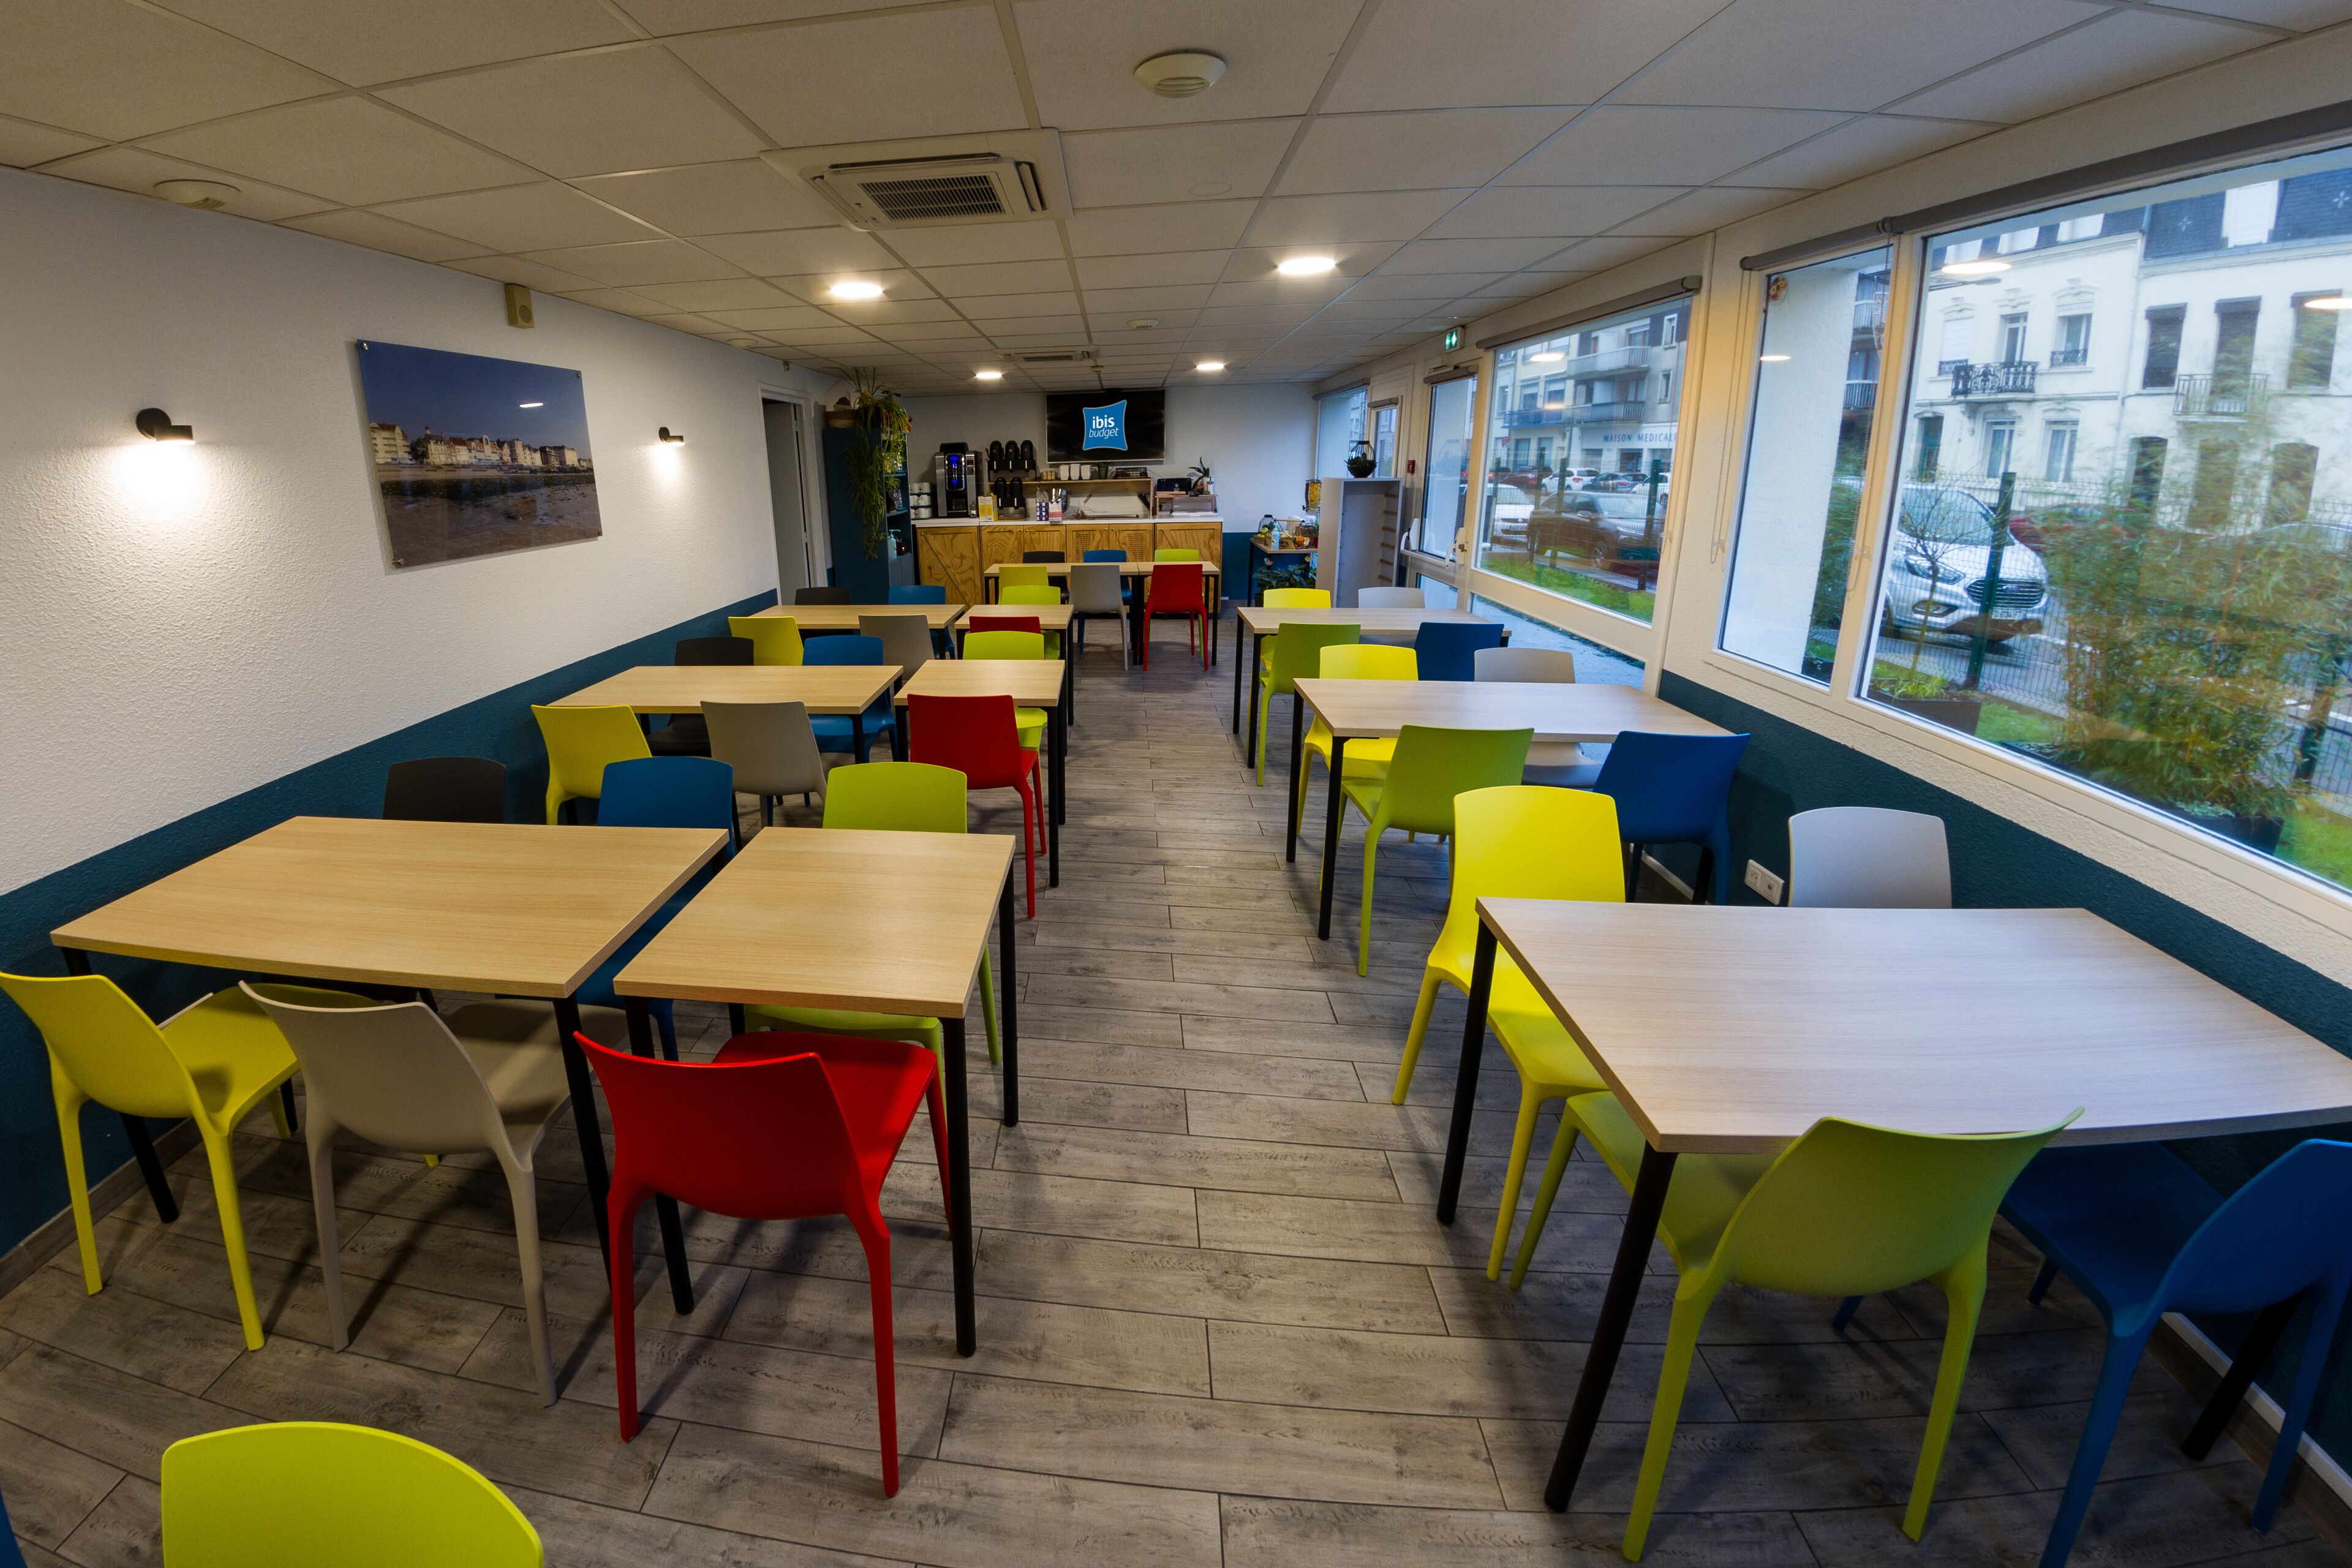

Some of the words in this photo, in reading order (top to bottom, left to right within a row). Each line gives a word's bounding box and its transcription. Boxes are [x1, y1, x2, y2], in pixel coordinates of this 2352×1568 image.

[1092, 415, 1115, 429] ibis
[1088, 427, 1120, 439] budget
[1603, 434, 1632, 443] MAISON
